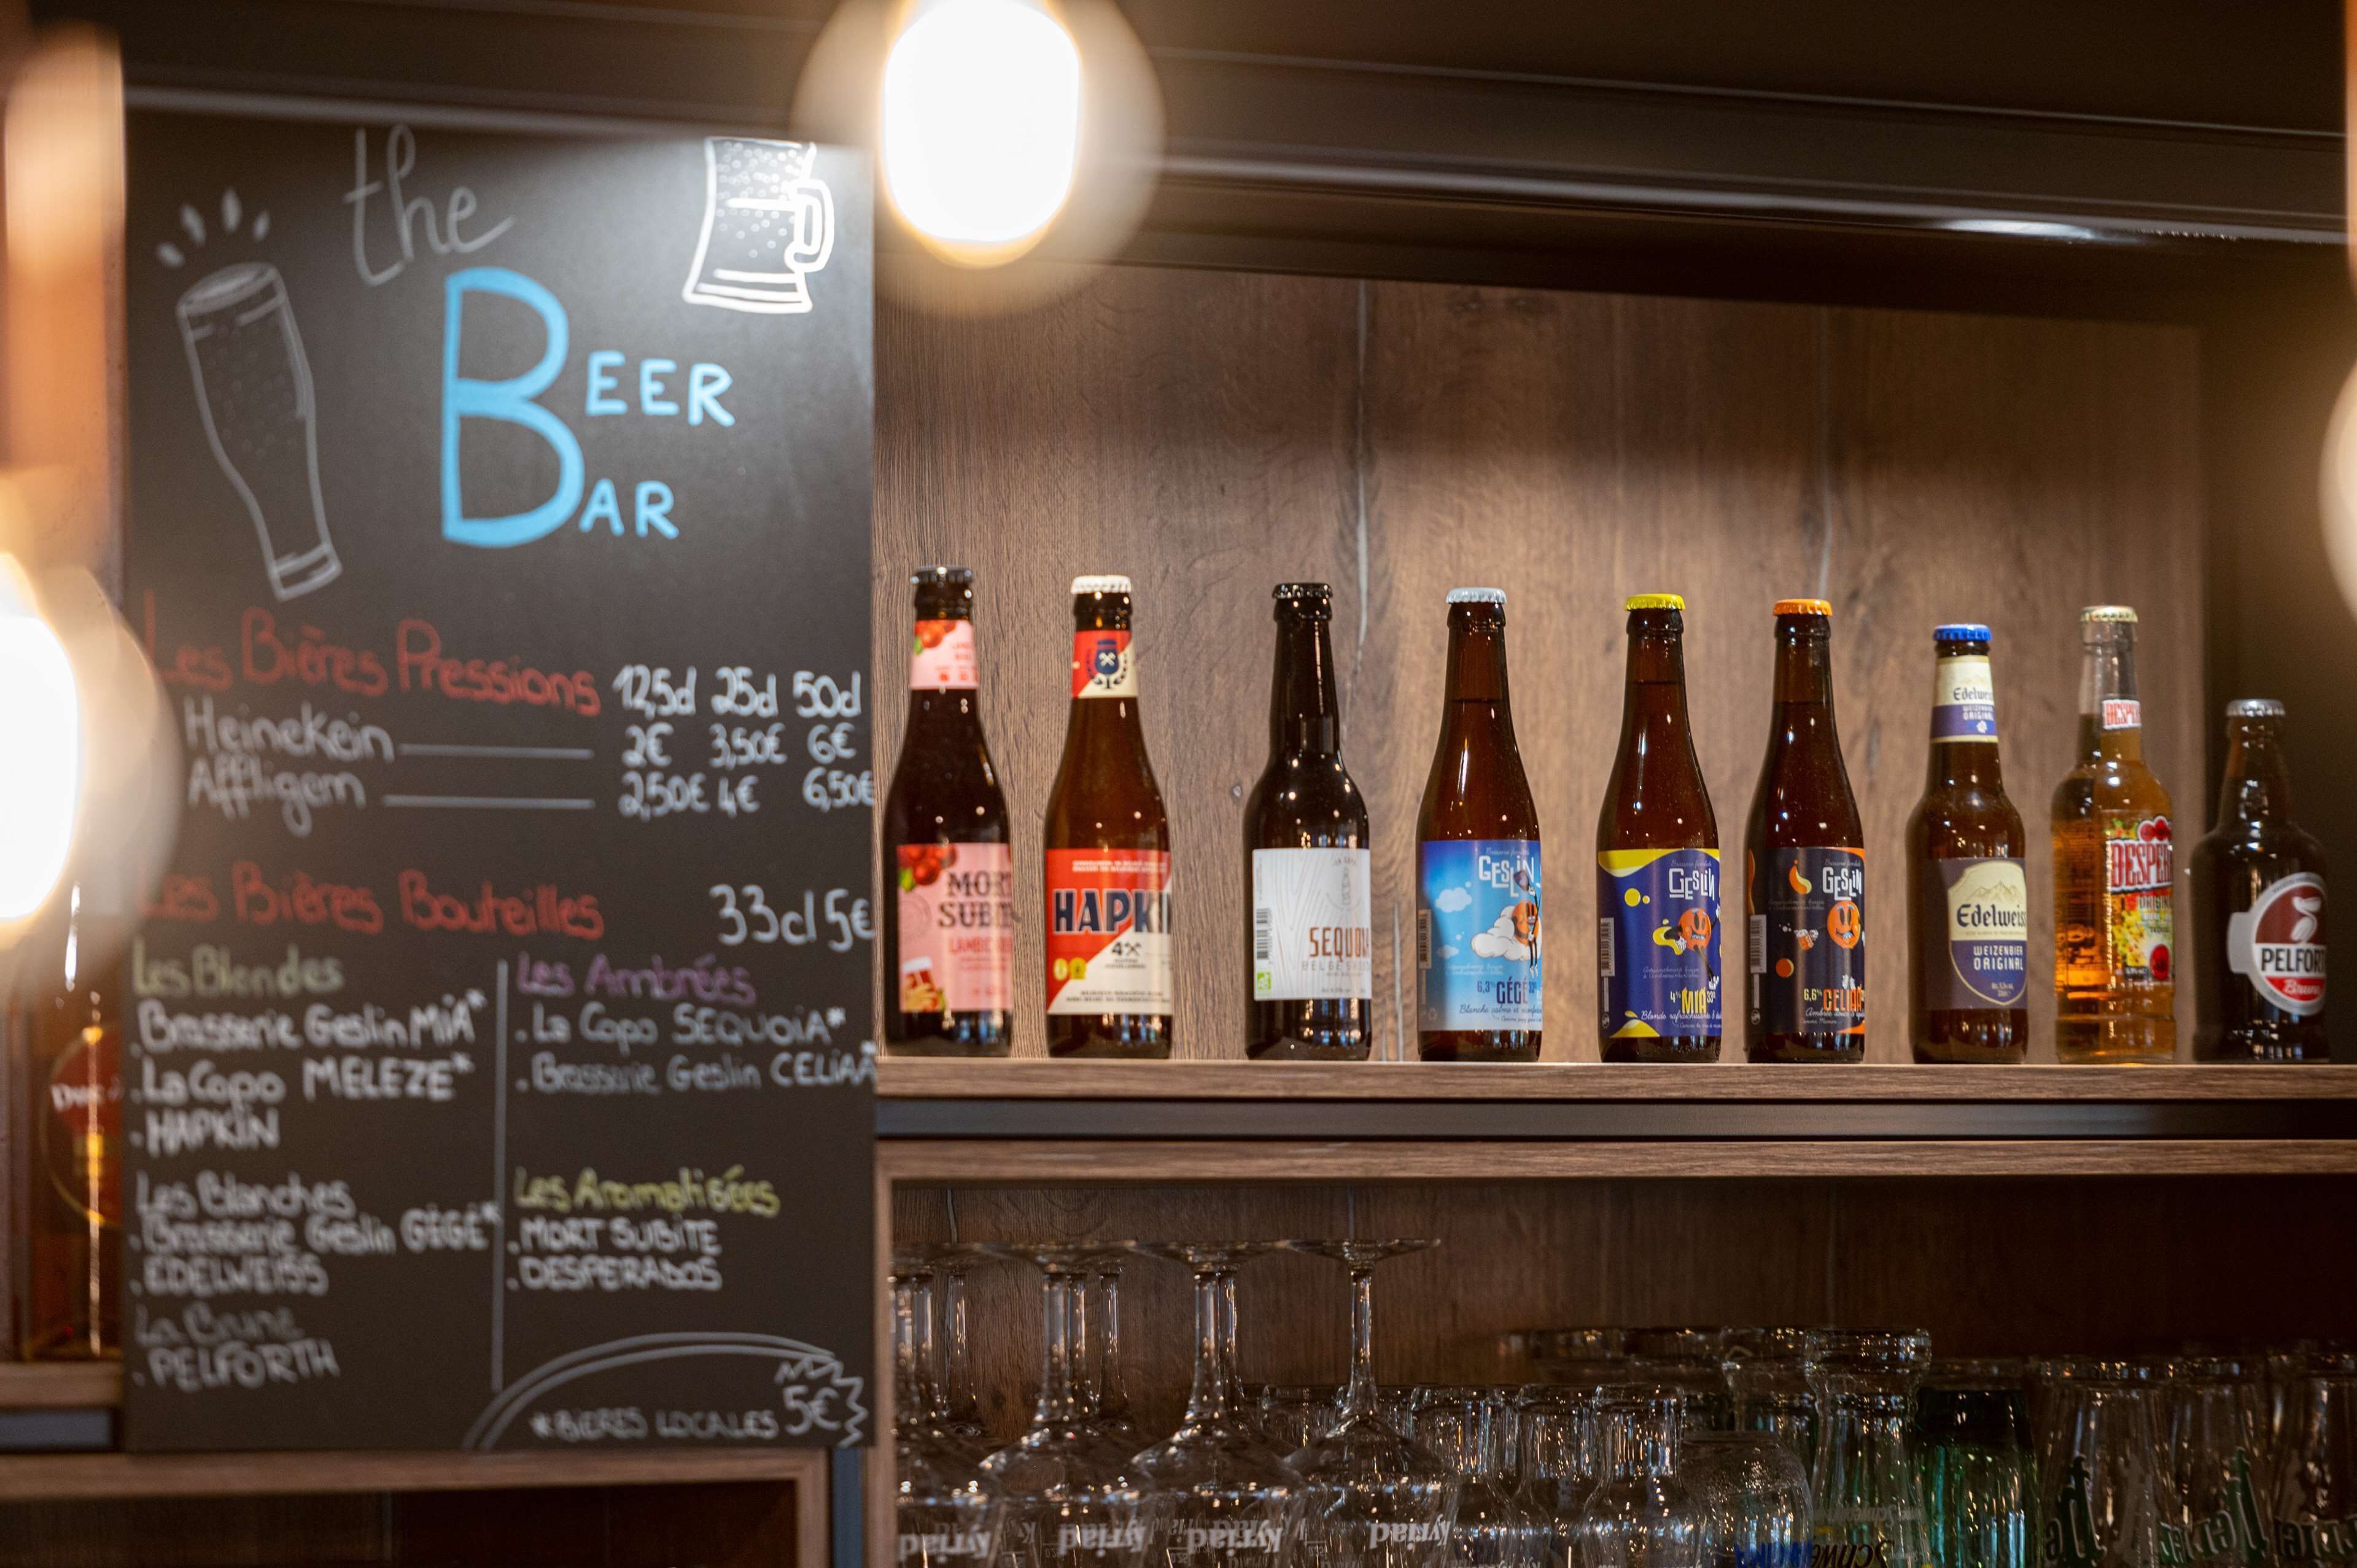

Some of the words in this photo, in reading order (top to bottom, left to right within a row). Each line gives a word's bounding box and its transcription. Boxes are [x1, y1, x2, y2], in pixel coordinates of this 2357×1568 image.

[346, 123, 516, 284] the
[396, 618, 601, 717] Pressions
[621, 721, 674, 767] 2€
[807, 721, 857, 764] 6€
[709, 884, 817, 945] 33cl
[1973, 957, 2024, 971] ORIGINAL
